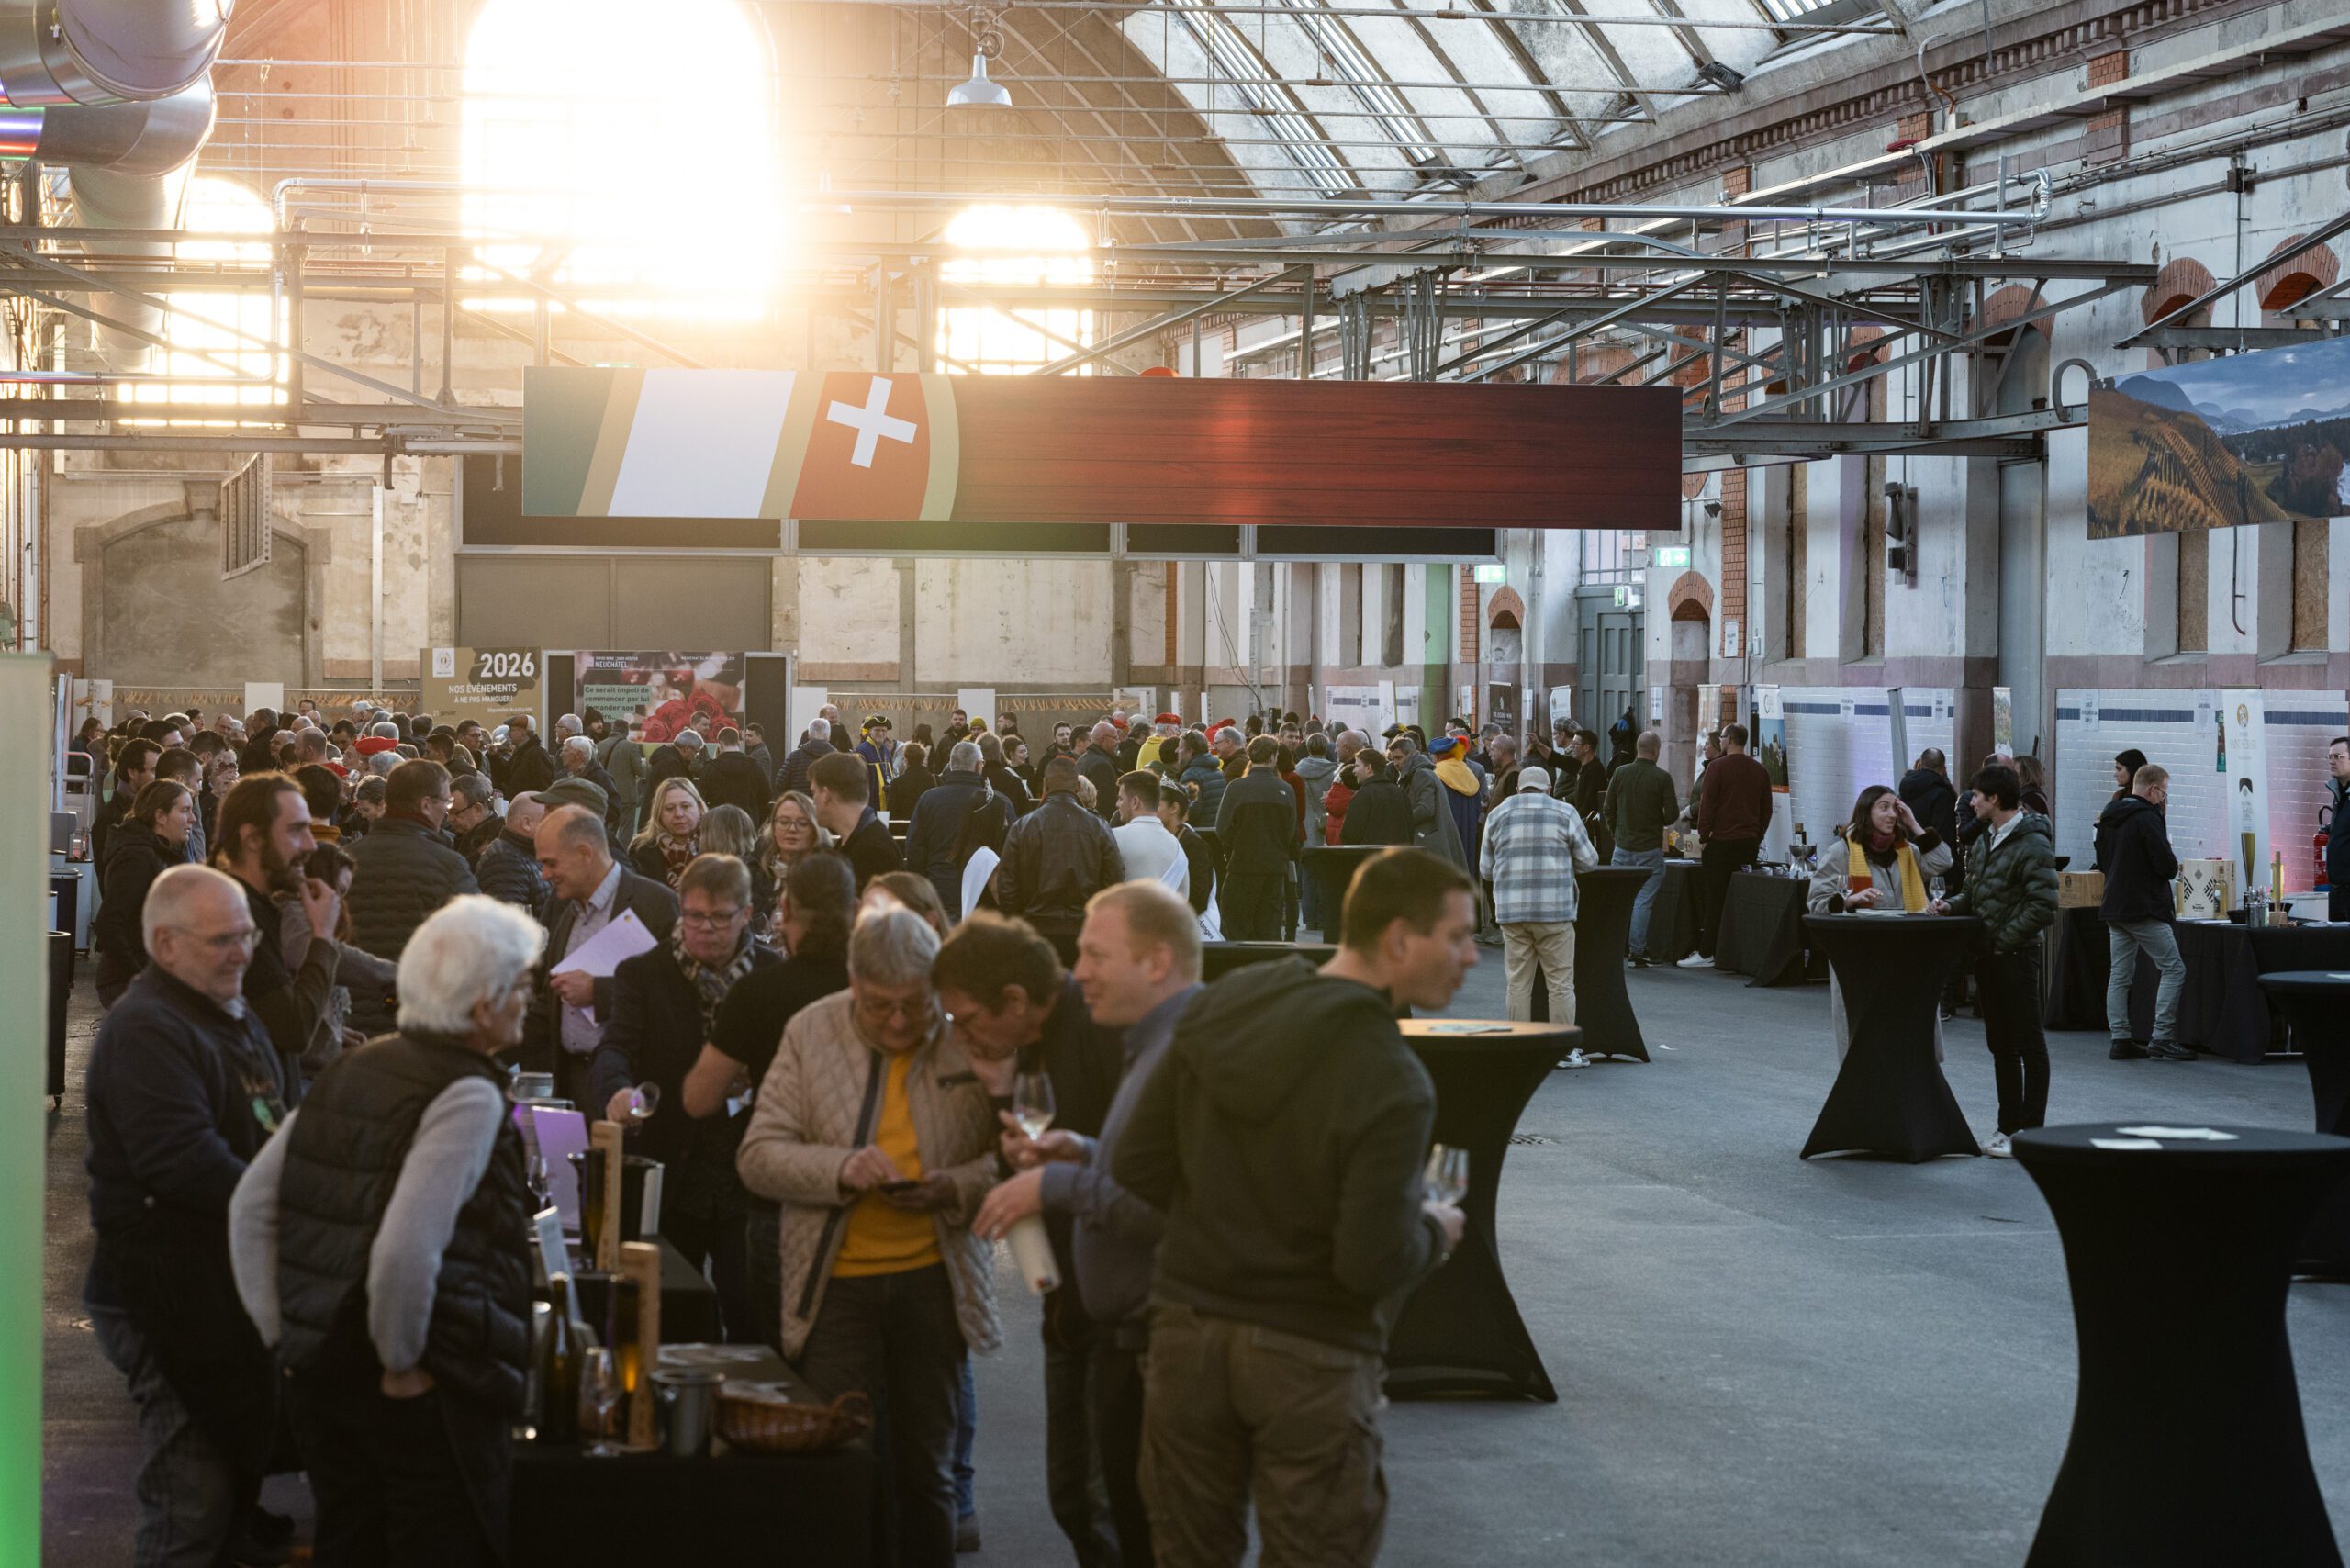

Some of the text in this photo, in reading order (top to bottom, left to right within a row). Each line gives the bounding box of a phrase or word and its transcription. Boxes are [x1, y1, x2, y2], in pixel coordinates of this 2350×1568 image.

[480, 652, 535, 678] 2026
[448, 682, 518, 694] NOS ÉVÉNEMENTS
[617, 687, 640, 695] impoli
[454, 695, 460, 704] À
[460, 696, 468, 704] NE
[469, 696, 481, 704] PAS
